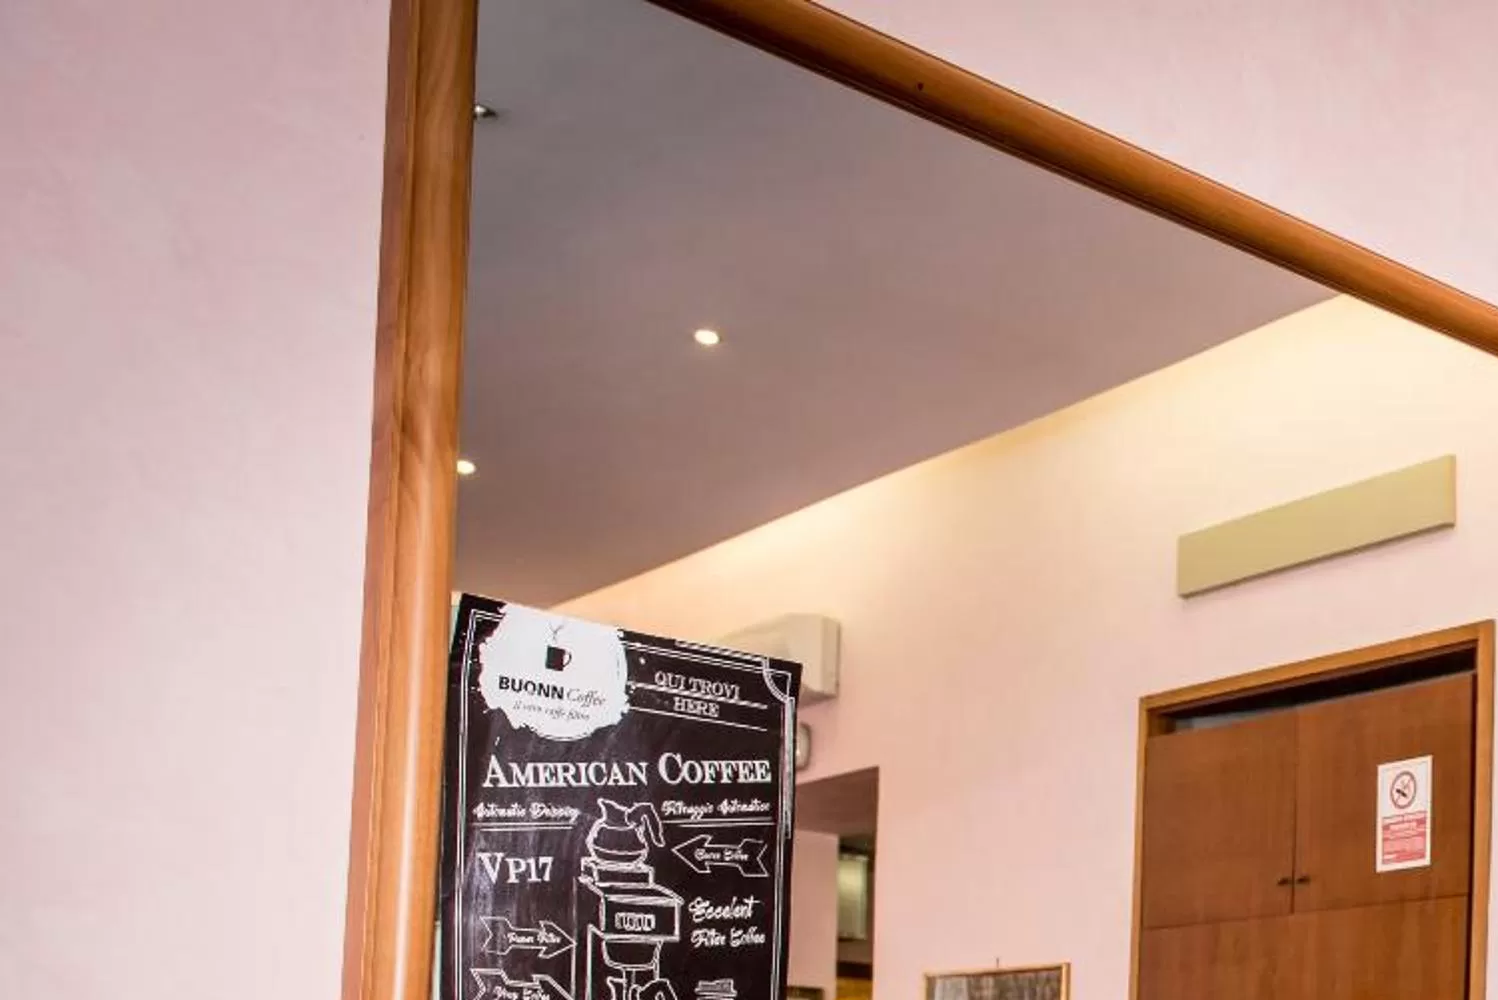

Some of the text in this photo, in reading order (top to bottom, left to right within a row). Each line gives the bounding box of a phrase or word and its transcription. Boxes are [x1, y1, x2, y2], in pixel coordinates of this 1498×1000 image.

[498, 675, 606, 708] BUONN Coffee
[654, 670, 740, 701] QUI TROVI
[672, 696, 719, 718] HERE
[482, 752, 773, 788] AMERICAN COFFEE
[475, 852, 554, 885] VP17
